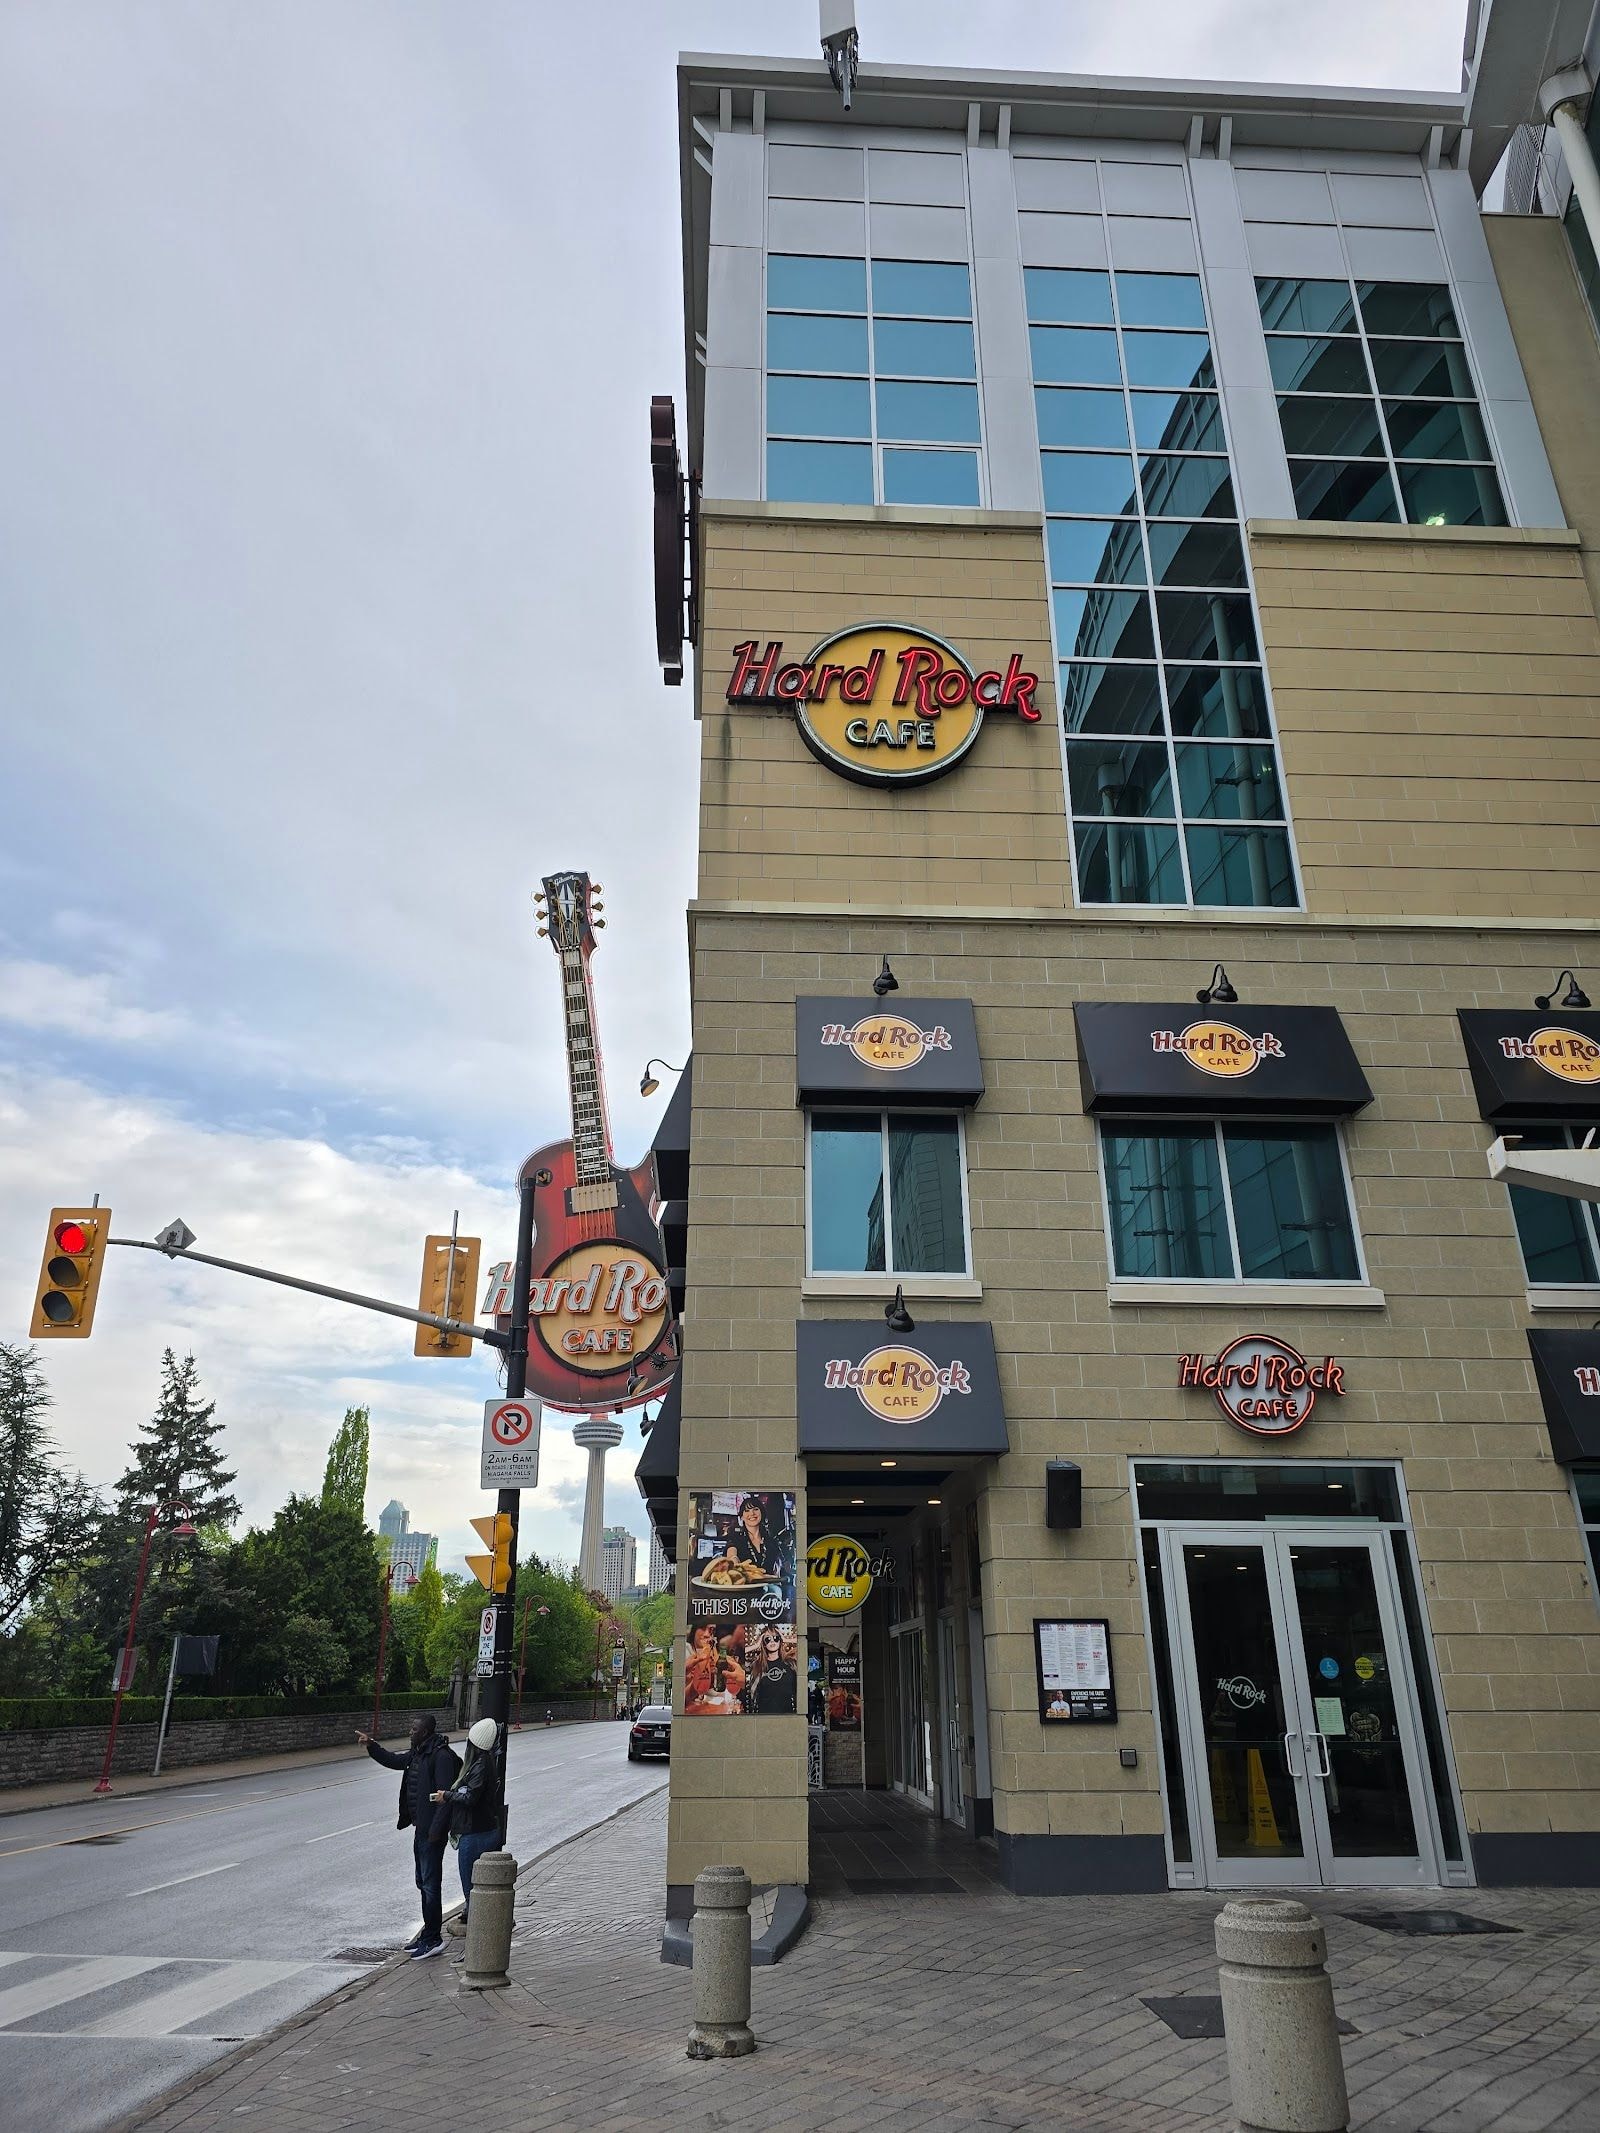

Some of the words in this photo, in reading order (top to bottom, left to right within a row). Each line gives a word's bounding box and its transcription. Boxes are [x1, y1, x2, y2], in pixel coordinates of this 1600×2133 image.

[726, 640, 886, 705] Hard
[892, 646, 1042, 723] Rock
[845, 718, 936, 750] CAFE
[821, 1025, 886, 1045] Hard
[889, 1026, 951, 1050] Rock
[1151, 1031, 1215, 1052] Hard
[1218, 1033, 1284, 1057] Rock
[1500, 1037, 1563, 1058] Hard
[1565, 1040, 1600, 1061] Ro
[873, 1051, 905, 1059] CAFE
[1208, 1057, 1240, 1066] CAFE
[1561, 1064, 1594, 1072] CAFE
[481, 1261, 603, 1315] Hard
[604, 1259, 667, 1324] Ro
[562, 1328, 634, 1354] CAFE
[825, 1360, 896, 1388] Hard
[901, 1361, 971, 1394] Rock
[1178, 1354, 1261, 1389] Hard
[1264, 1355, 1346, 1396] Rock
[883, 1396, 919, 1407] CAFE
[1237, 1399, 1298, 1419] CAFE
[488, 1453, 532, 1464] 2AM-6AM
[807, 1548, 835, 1578] rd
[835, 1547, 896, 1584] Rock
[820, 1585, 853, 1599] CAFE
[692, 1598, 730, 1616] THIS
[732, 1598, 748, 1615] IS
[750, 1598, 771, 1608] Hard
[770, 1598, 792, 1610] Rock
[837, 1666, 856, 1674] HOUR
[1216, 1678, 1243, 1695] Hard
[1242, 1684, 1266, 1704] Rock
